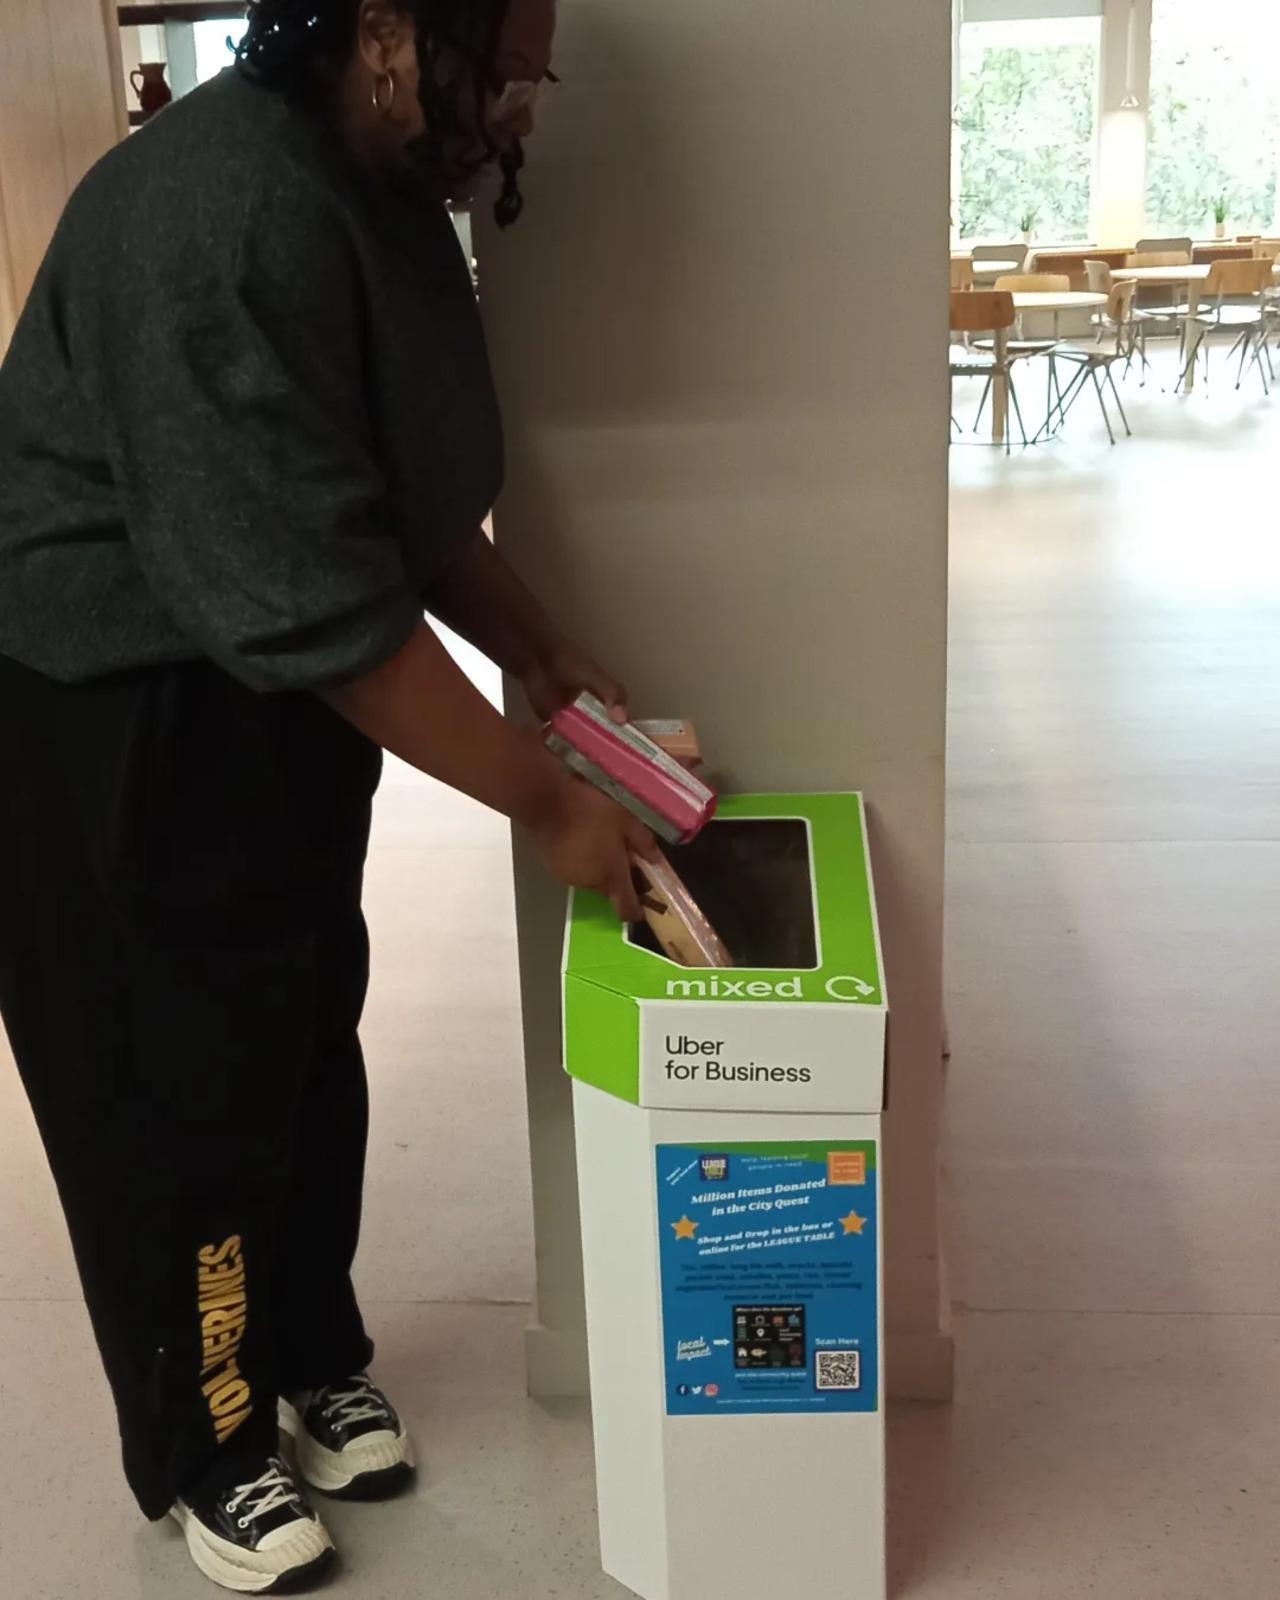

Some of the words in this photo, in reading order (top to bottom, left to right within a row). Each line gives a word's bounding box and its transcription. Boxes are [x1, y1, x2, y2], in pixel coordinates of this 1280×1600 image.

[666, 975, 803, 998] mixed
[665, 1035, 725, 1055] Uber
[664, 1060, 700, 1080] for
[705, 1061, 812, 1083] Business
[691, 1190, 736, 1205] Million
[737, 1186, 773, 1198] Items
[774, 1178, 827, 1194] Donated
[711, 1206, 725, 1217] in
[726, 1203, 747, 1214] the
[748, 1199, 773, 1212] City
[774, 1195, 809, 1209] Quest
[697, 1234, 723, 1245] Shop
[724, 1230, 743, 1242] and
[744, 1228, 770, 1239] Drop
[771, 1226, 782, 1235] in
[784, 1224, 800, 1233] the
[698, 1244, 730, 1256] online
[730, 1241, 747, 1252] for
[746, 1239, 763, 1250] the
[763, 1235, 802, 1249] LEAGUE
[803, 1230, 836, 1243] TABLE
[815, 1337, 838, 1346] Scan
[838, 1337, 859, 1346] Here
